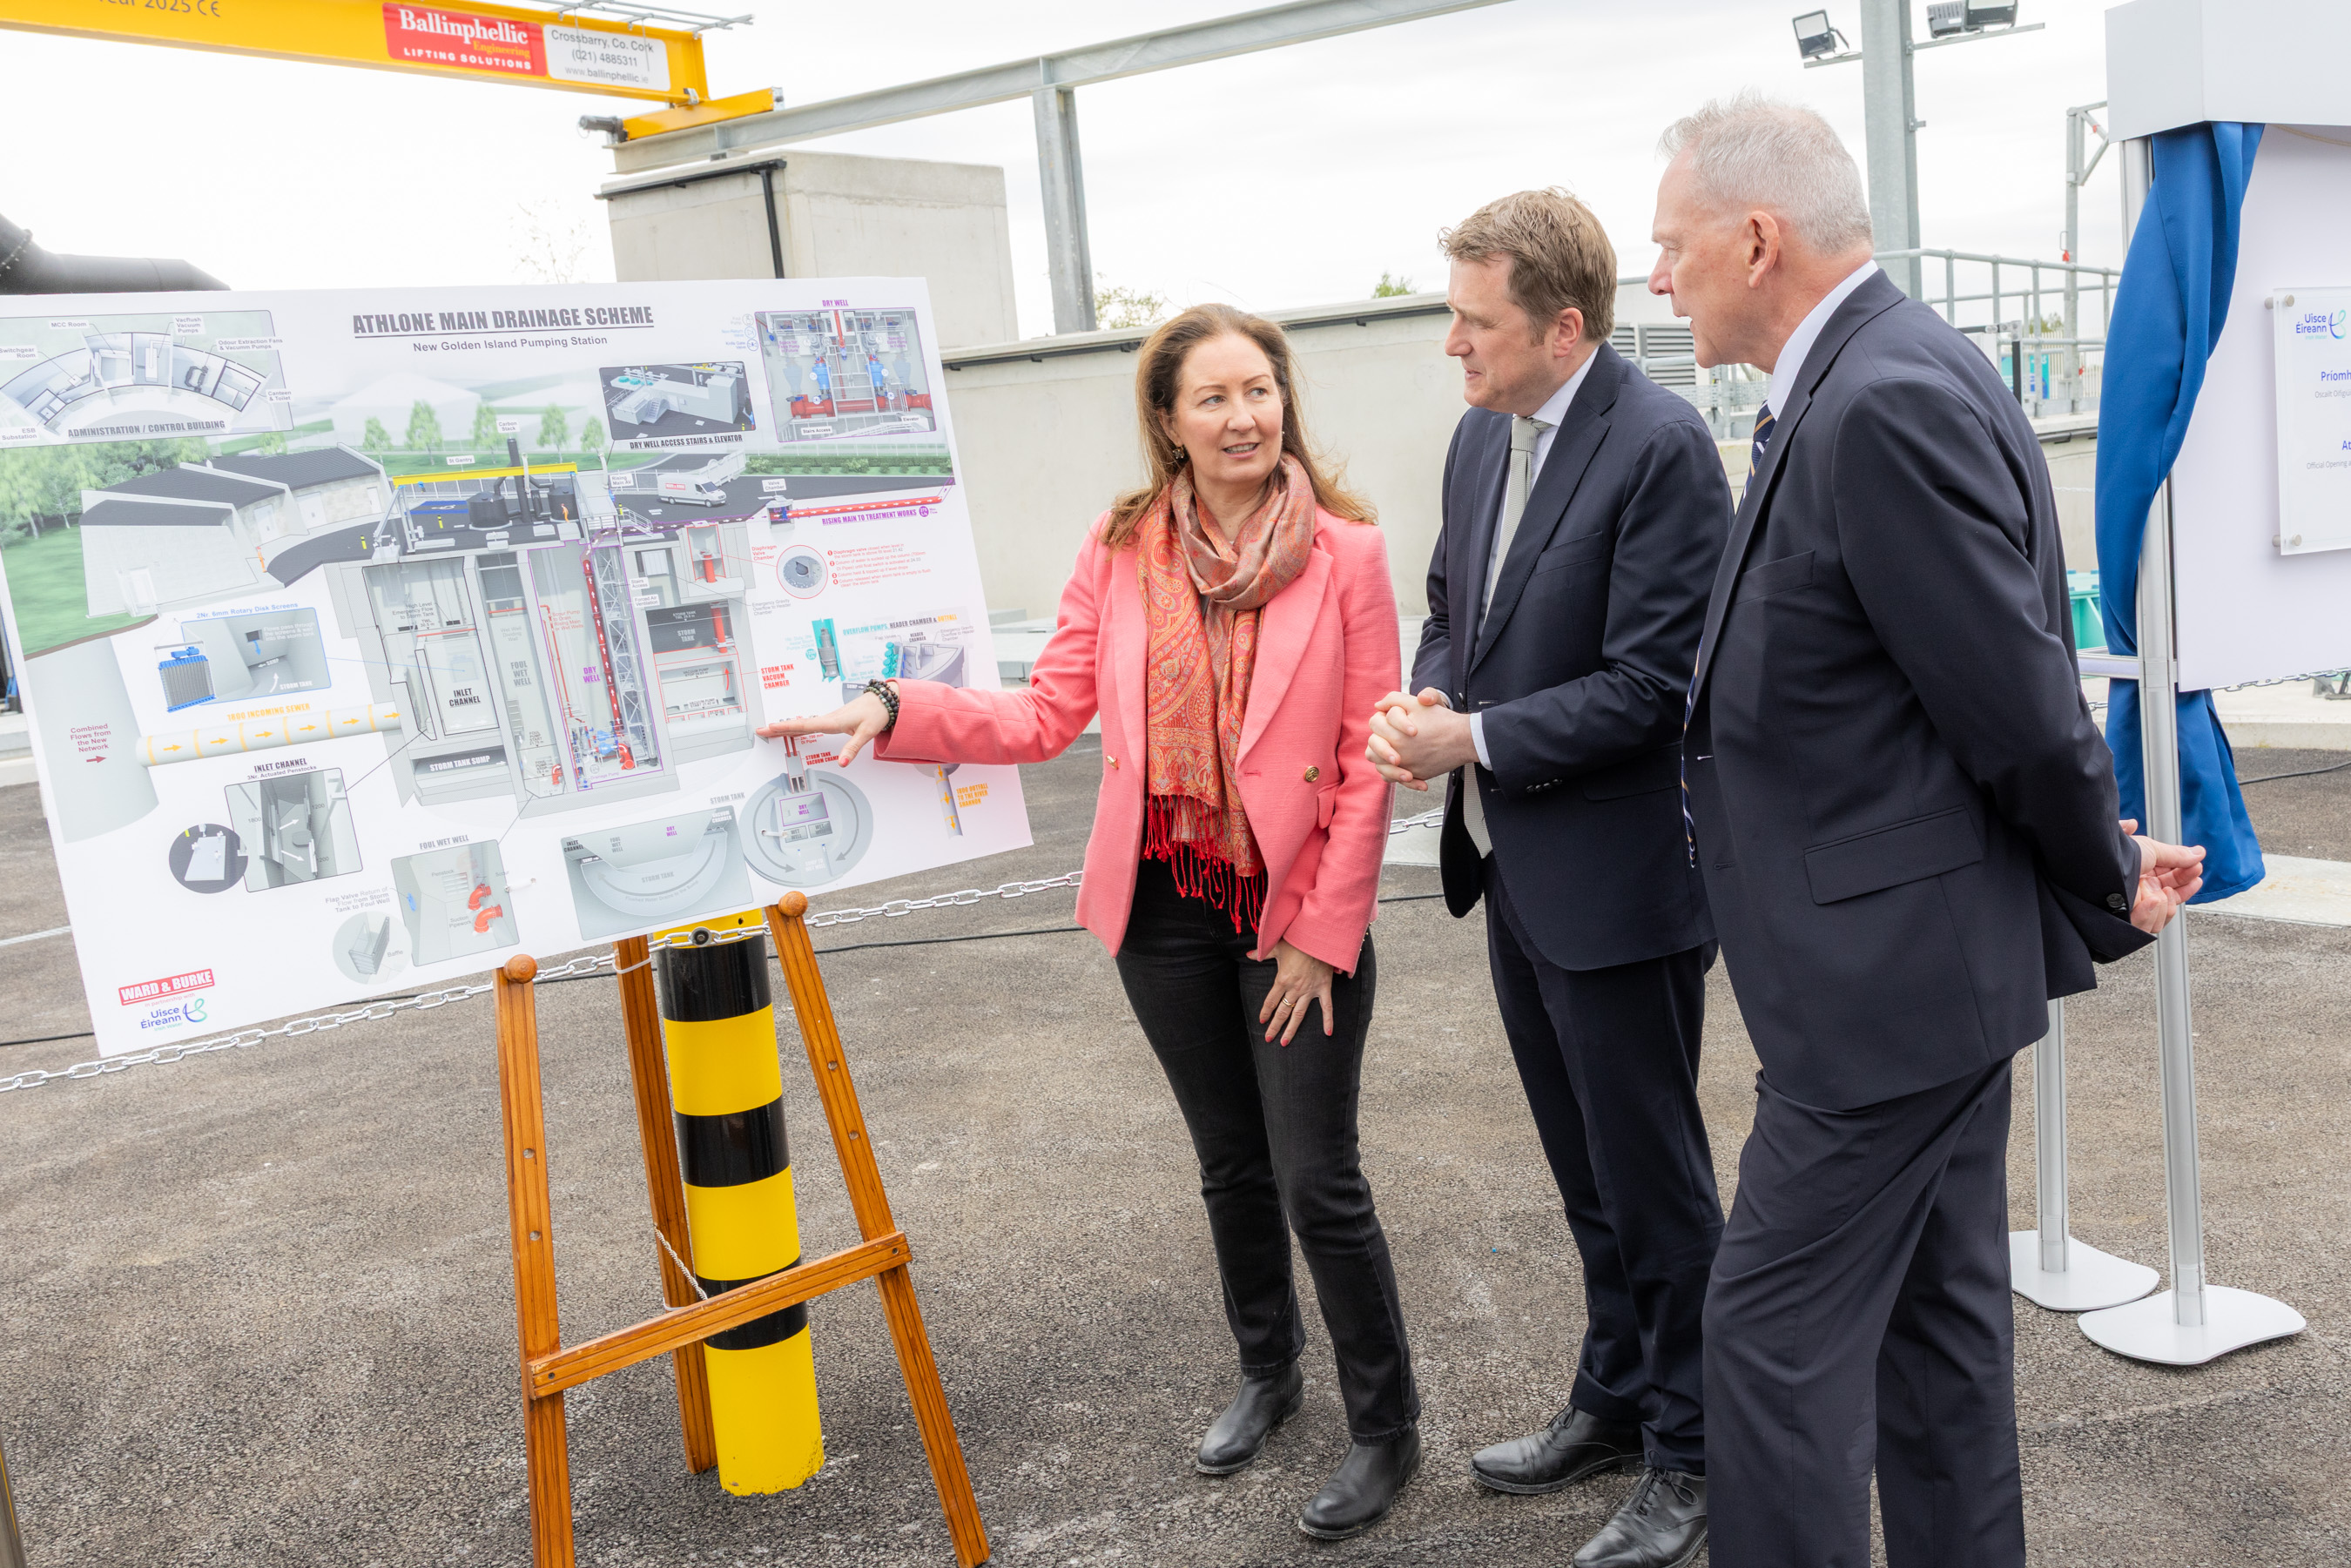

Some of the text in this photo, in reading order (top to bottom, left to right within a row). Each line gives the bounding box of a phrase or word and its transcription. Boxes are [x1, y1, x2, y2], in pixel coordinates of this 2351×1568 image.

[398, 9, 529, 44] Ballinphellic
[551, 29, 654, 53] Crossbarry, Co. Cork
[473, 40, 531, 60] Engineering
[571, 48, 638, 67] (021) 4885311
[404, 47, 531, 70] LIFTING SOLUTIONS
[564, 66, 650, 84] www.ballinphellic.ie
[353, 306, 654, 333] ATHLONE MAIN DRAINAGE SCHEME
[2304, 313, 2327, 323] Uisce
[2295, 321, 2327, 334] Éireann
[413, 335, 608, 352] New Golden Island Pumping Station
[68, 425, 140, 438] ADMINISTRATION
[149, 422, 186, 433] CONTROL
[187, 421, 226, 430] BUILDING
[643, 441, 660, 449] WELL
[660, 438, 686, 448] ACCESS
[714, 434, 743, 444] ELEVATOR
[822, 516, 841, 525] RISING
[842, 515, 858, 523] MAIN
[866, 510, 896, 521] TREATMENT
[230, 607, 253, 616] Rotary
[271, 602, 298, 611] Screens
[583, 665, 596, 675] DRY
[761, 663, 794, 675] STORM TANK
[583, 674, 601, 683] WELL
[762, 672, 785, 682] VACUUM
[764, 679, 790, 690] CHAMBER
[454, 688, 472, 697] INLET
[448, 696, 481, 707] CHANNEL
[247, 706, 285, 718] INCOMING
[285, 703, 310, 713] SEWER
[70, 723, 108, 734] Combined
[78, 744, 109, 753] Network
[254, 757, 307, 773] INLET CHANNEL
[429, 755, 490, 772] STORM TANK SUMP
[420, 835, 469, 850] FOUL WET WELL
[121, 971, 212, 1001] WARD & BURKE
[151, 1006, 179, 1019] Uisce
[140, 1015, 182, 1029] Éireann
